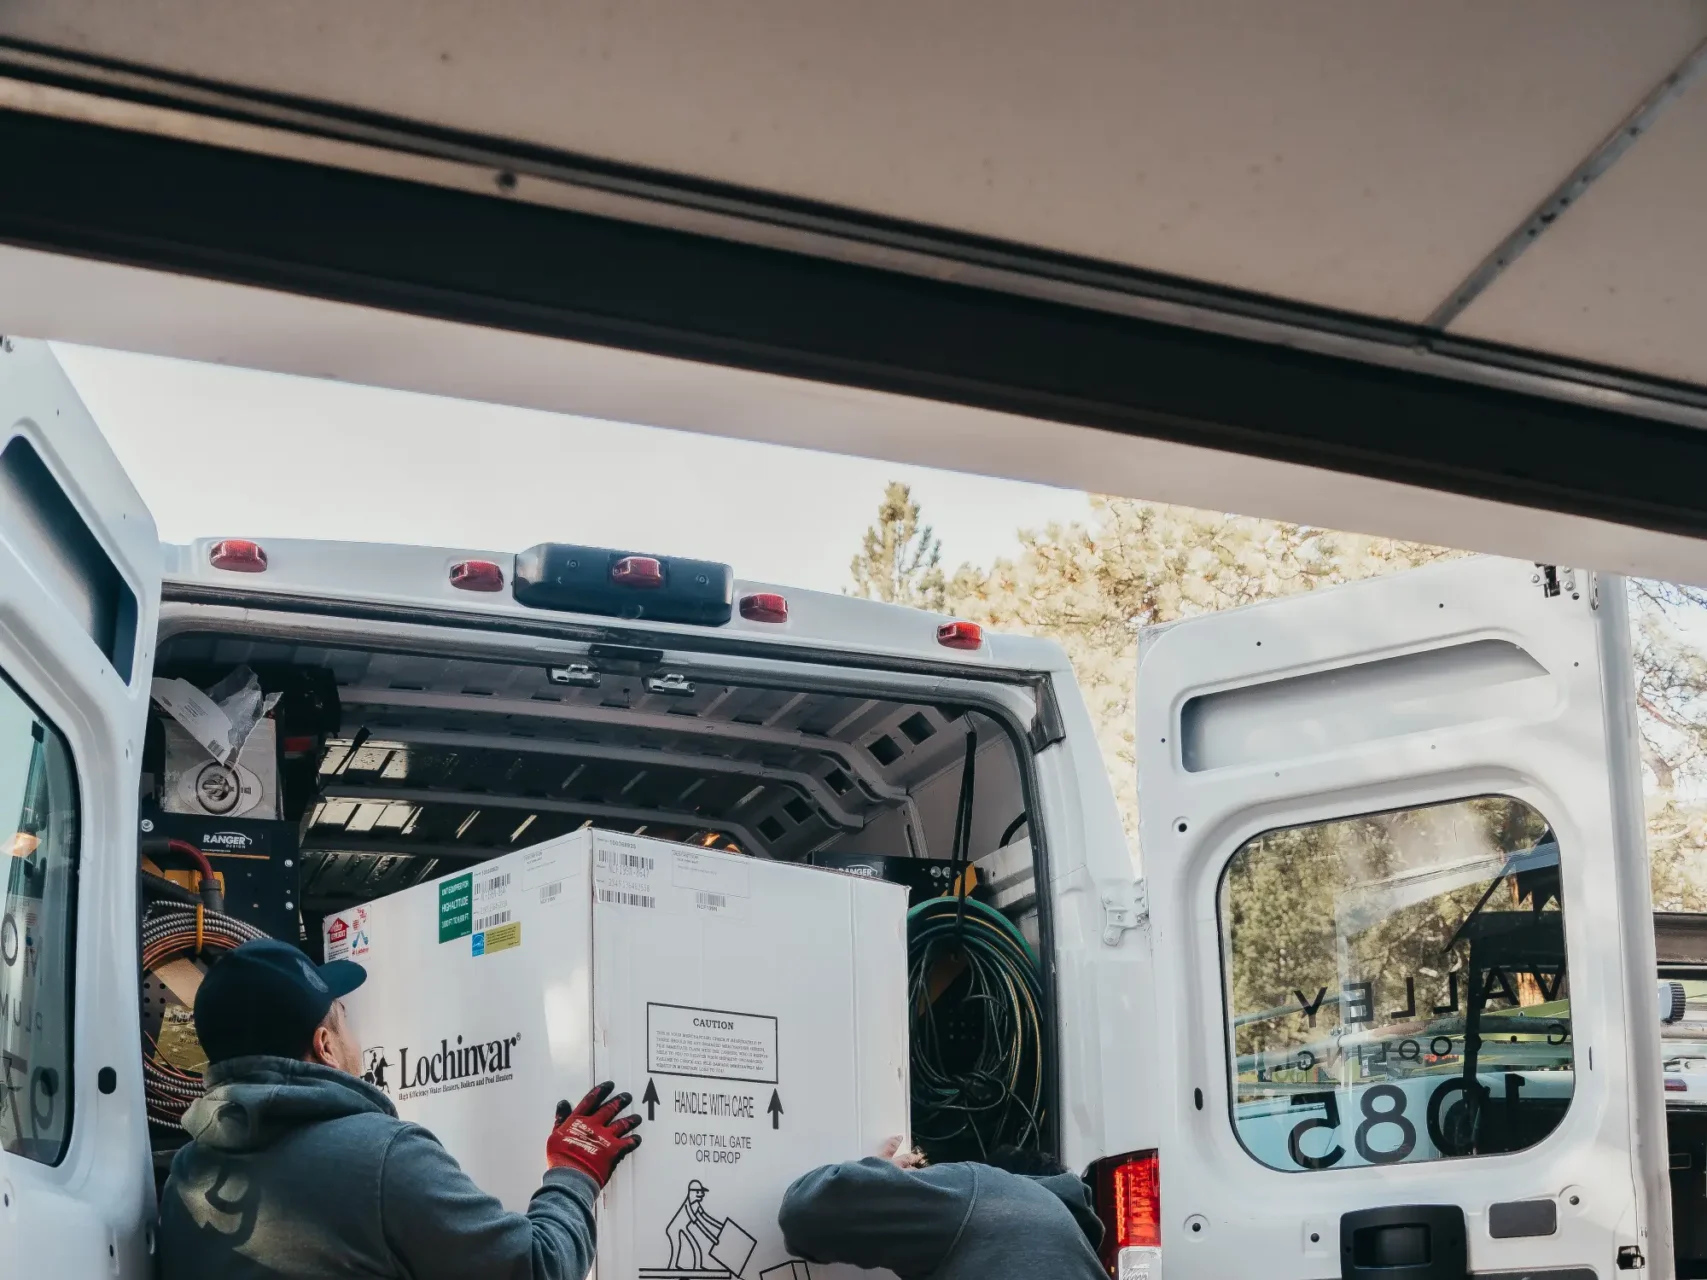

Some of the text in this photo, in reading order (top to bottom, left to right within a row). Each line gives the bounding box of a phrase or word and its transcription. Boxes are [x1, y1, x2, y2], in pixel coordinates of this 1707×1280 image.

[203, 833, 246, 845] RANGER
[692, 1017, 734, 1030] CAUTION
[475, 1078, 485, 1086] and
[484, 1076, 495, 1084] Pool
[674, 1090, 755, 1119] HANDLE WITH CARE
[674, 1132, 752, 1150] DO NOT TAIL GATE
[695, 1149, 741, 1164] OR DROP
